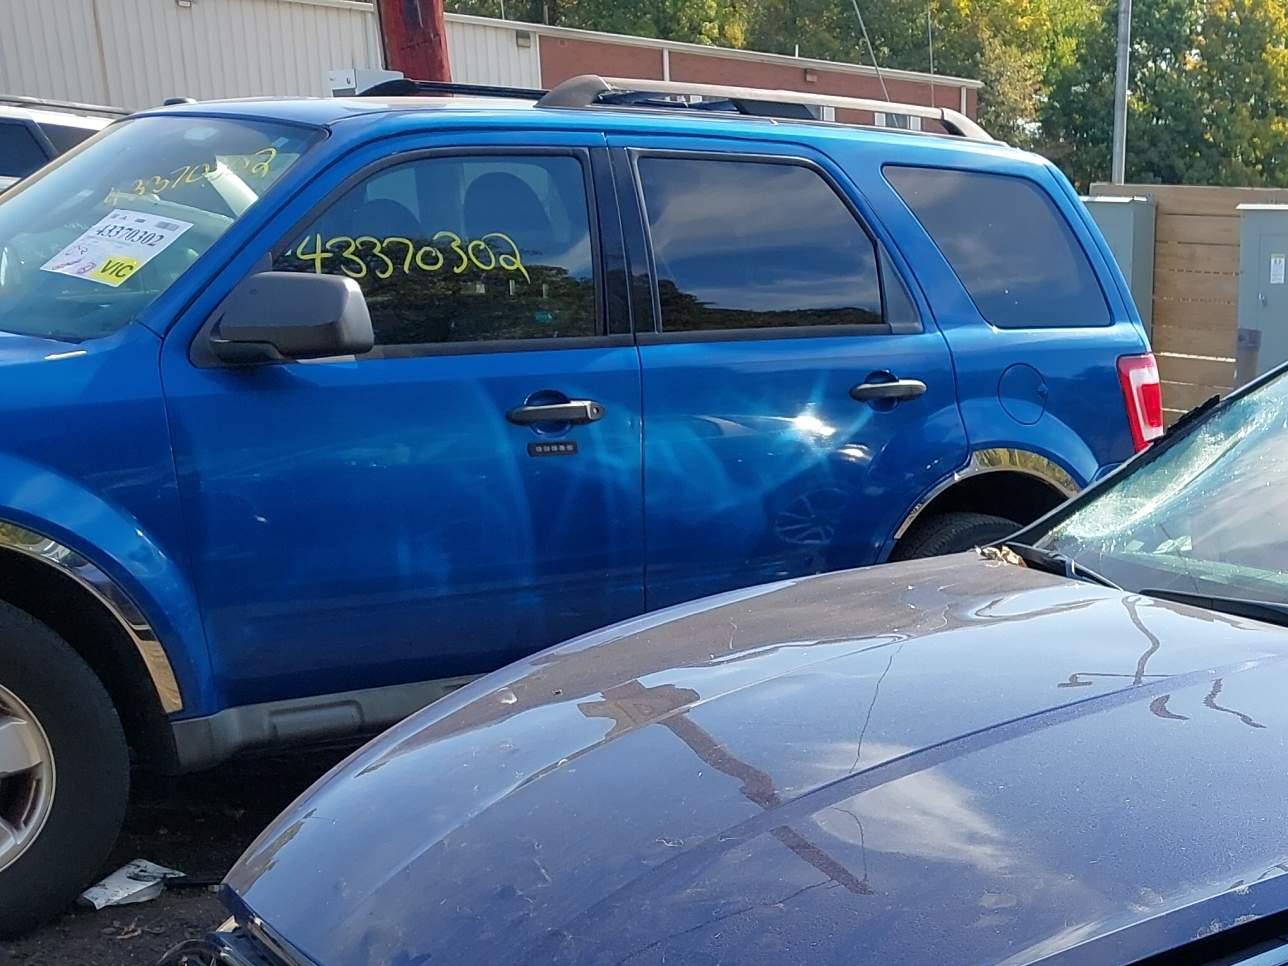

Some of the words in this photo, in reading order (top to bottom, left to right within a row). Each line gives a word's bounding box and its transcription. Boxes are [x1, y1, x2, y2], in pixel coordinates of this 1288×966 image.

[96, 224, 165, 247] 43370302
[100, 259, 134, 278] VIC
[297, 231, 530, 284] 43370302
